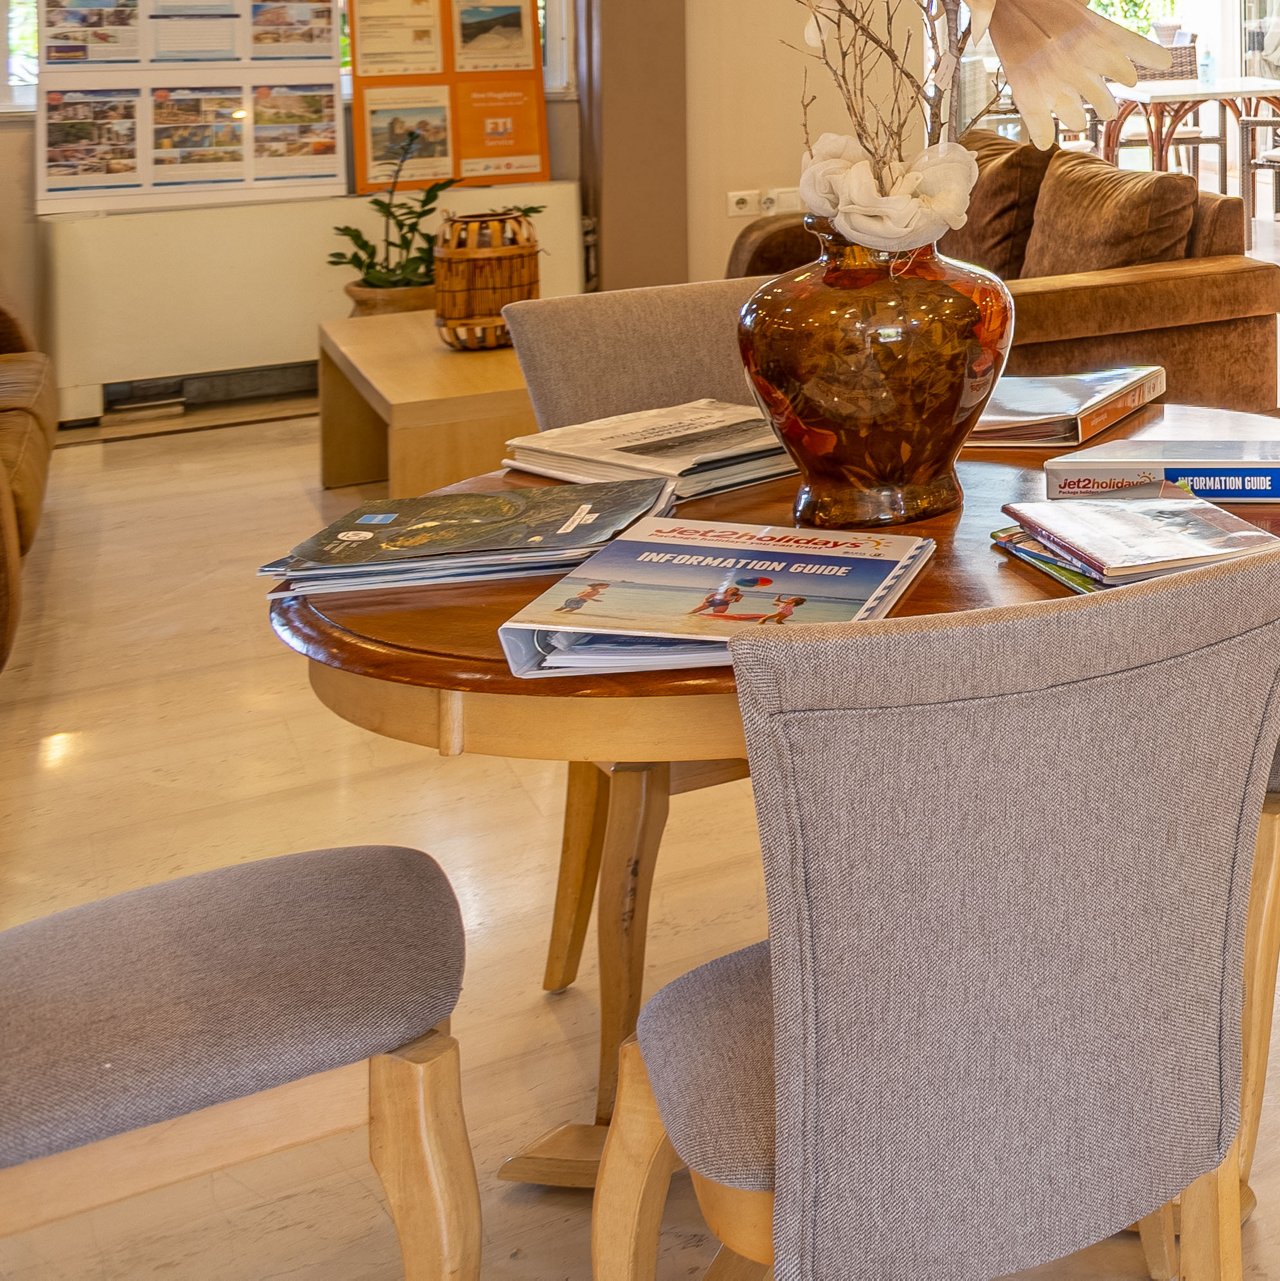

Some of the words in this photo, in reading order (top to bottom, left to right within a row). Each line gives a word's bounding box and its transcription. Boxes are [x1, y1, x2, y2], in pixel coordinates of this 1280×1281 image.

[1244, 476, 1272, 491] GUIDE
[649, 533, 702, 542] Package
[701, 537, 747, 546] holidays
[749, 540, 770, 548] you
[655, 525, 867, 550] Jet2holidays
[636, 550, 786, 573] INFORMATION
[789, 563, 853, 578] GUIDE
